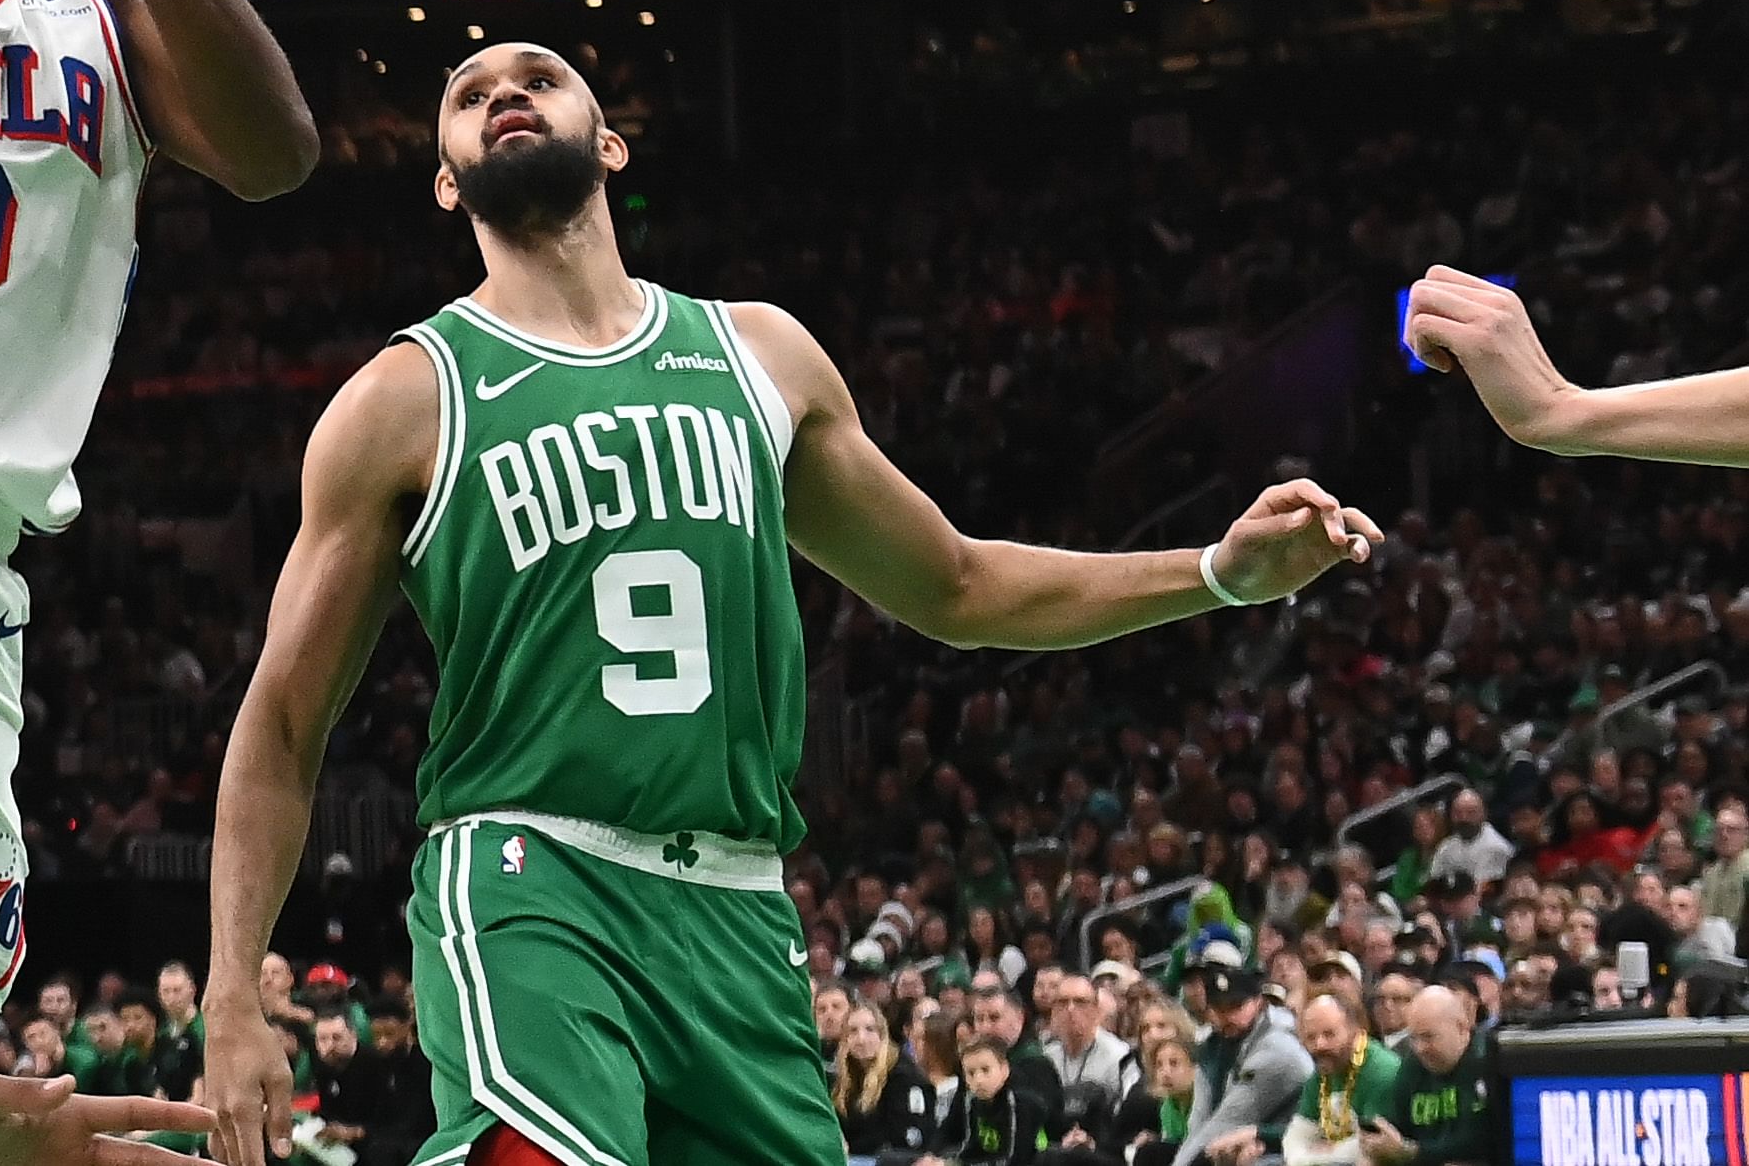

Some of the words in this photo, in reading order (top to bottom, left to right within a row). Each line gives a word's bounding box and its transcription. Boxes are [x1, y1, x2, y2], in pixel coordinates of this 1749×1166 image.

[653, 351, 730, 373] Amica
[478, 402, 755, 573] BOSTON
[592, 548, 713, 716] 9
[1539, 1090, 1595, 1166] NBA
